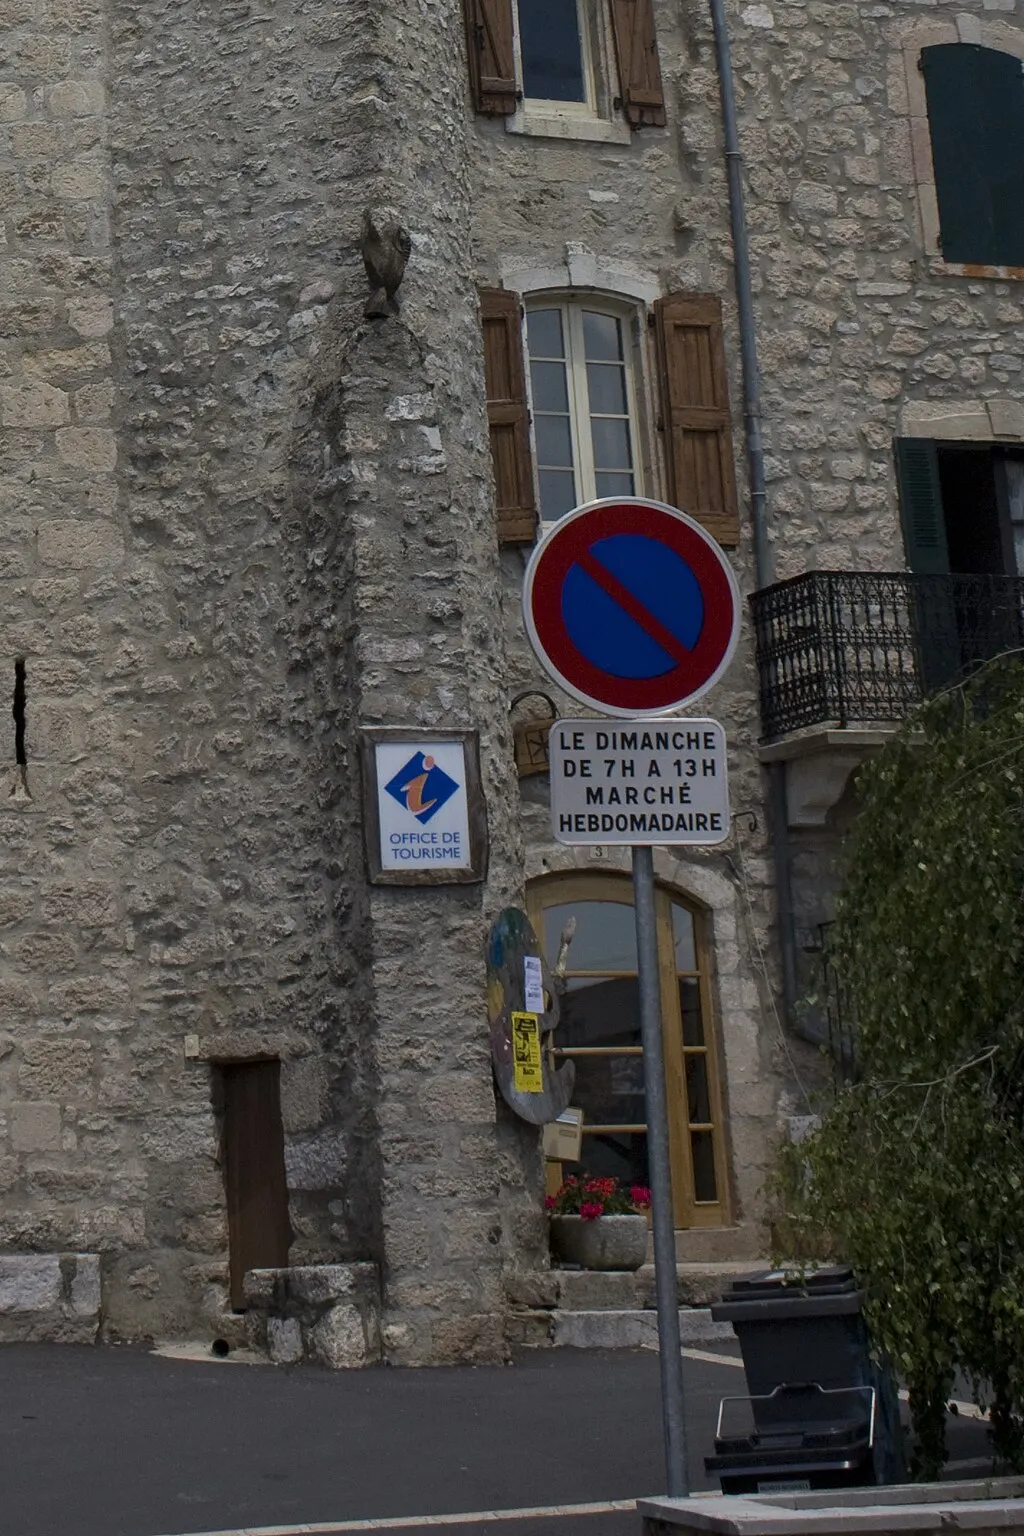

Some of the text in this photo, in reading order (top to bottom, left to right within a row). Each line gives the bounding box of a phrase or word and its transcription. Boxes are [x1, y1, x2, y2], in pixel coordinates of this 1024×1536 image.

[559, 731, 716, 751] LE DIMANCHE
[563, 759, 592, 778] DE
[647, 759, 662, 778] A
[585, 782, 692, 805] MARCHÉ
[559, 813, 722, 833] HEBDOMADAIRE
[389, 832, 461, 844] OFFICE DE
[391, 847, 461, 860] TOURISME
[595, 846, 603, 858] 3
